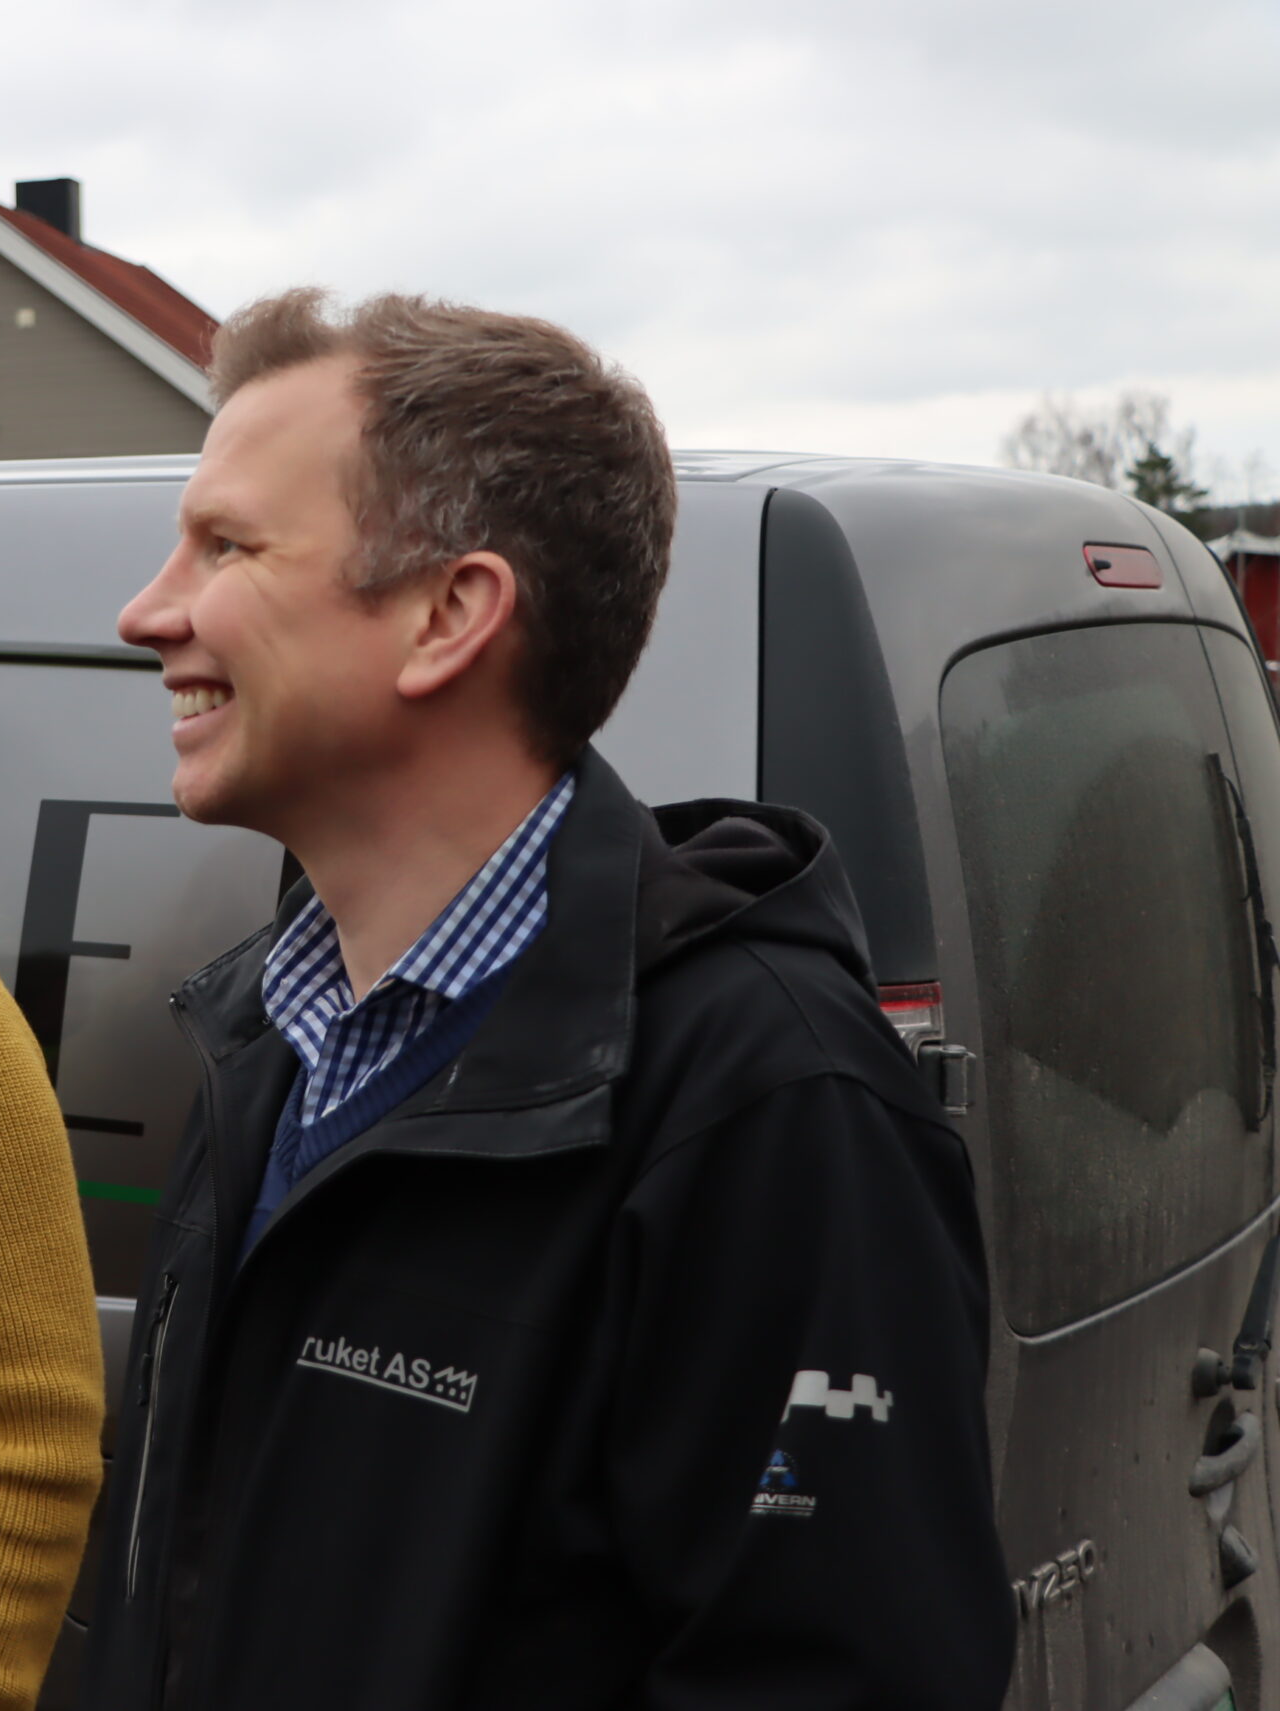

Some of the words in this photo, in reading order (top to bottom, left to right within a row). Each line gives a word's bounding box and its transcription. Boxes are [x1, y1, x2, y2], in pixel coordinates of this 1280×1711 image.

[302, 1336, 380, 1376] ruket
[383, 1352, 432, 1389] AS
[1011, 1539, 1097, 1617] V250
